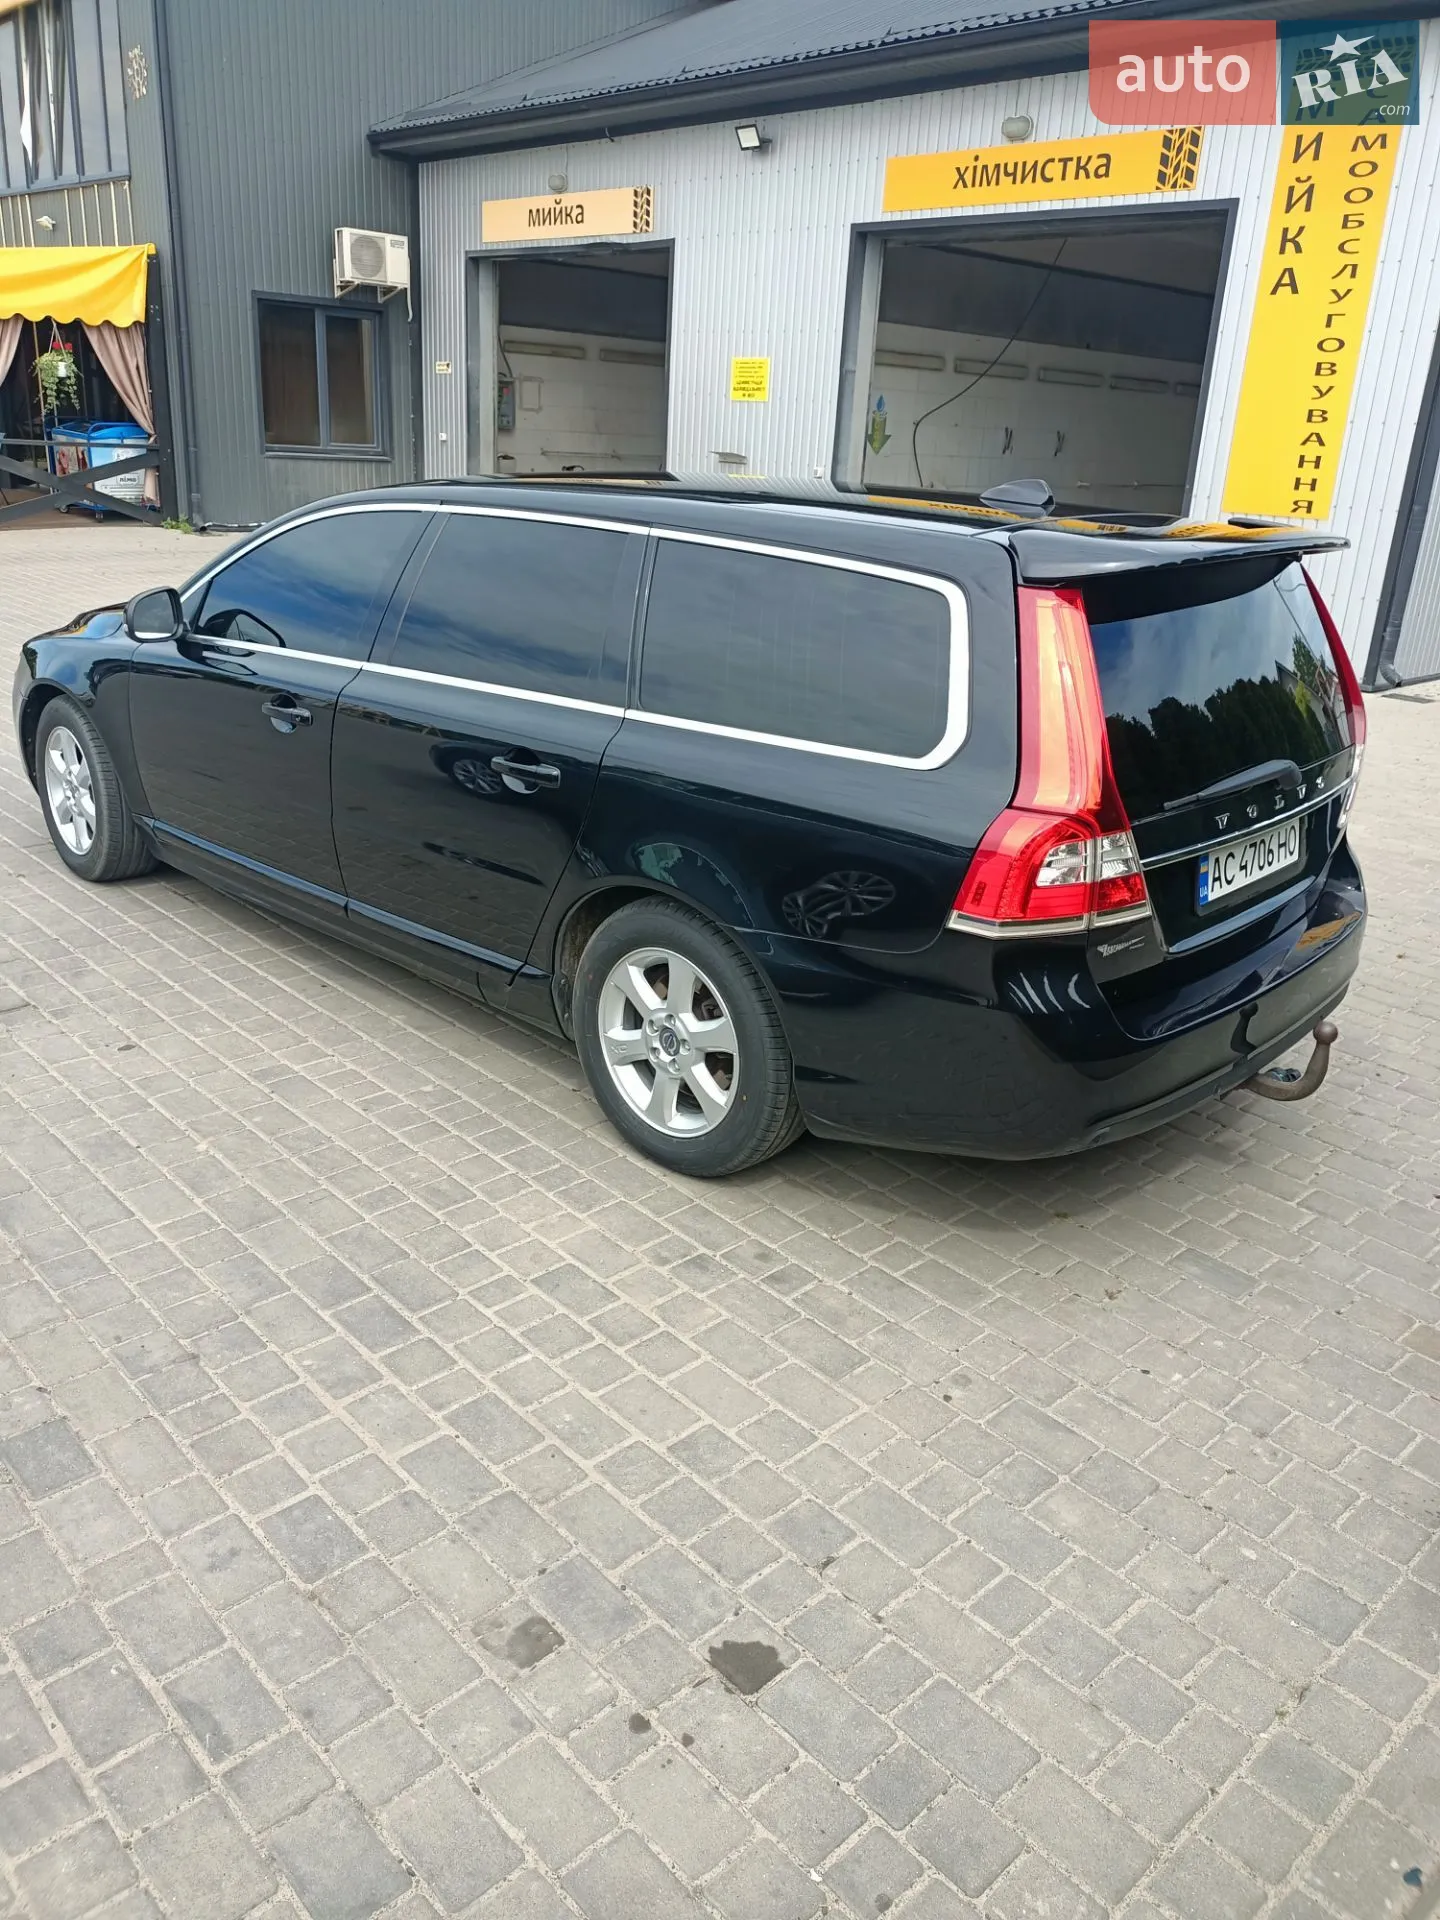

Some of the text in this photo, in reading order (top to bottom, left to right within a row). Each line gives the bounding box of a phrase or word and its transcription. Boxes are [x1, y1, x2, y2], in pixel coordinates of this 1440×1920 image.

[952, 152, 1112, 190] хімчистка
[528, 198, 585, 228] мийка
[1211, 824, 1297, 893] AC 4706 HO
